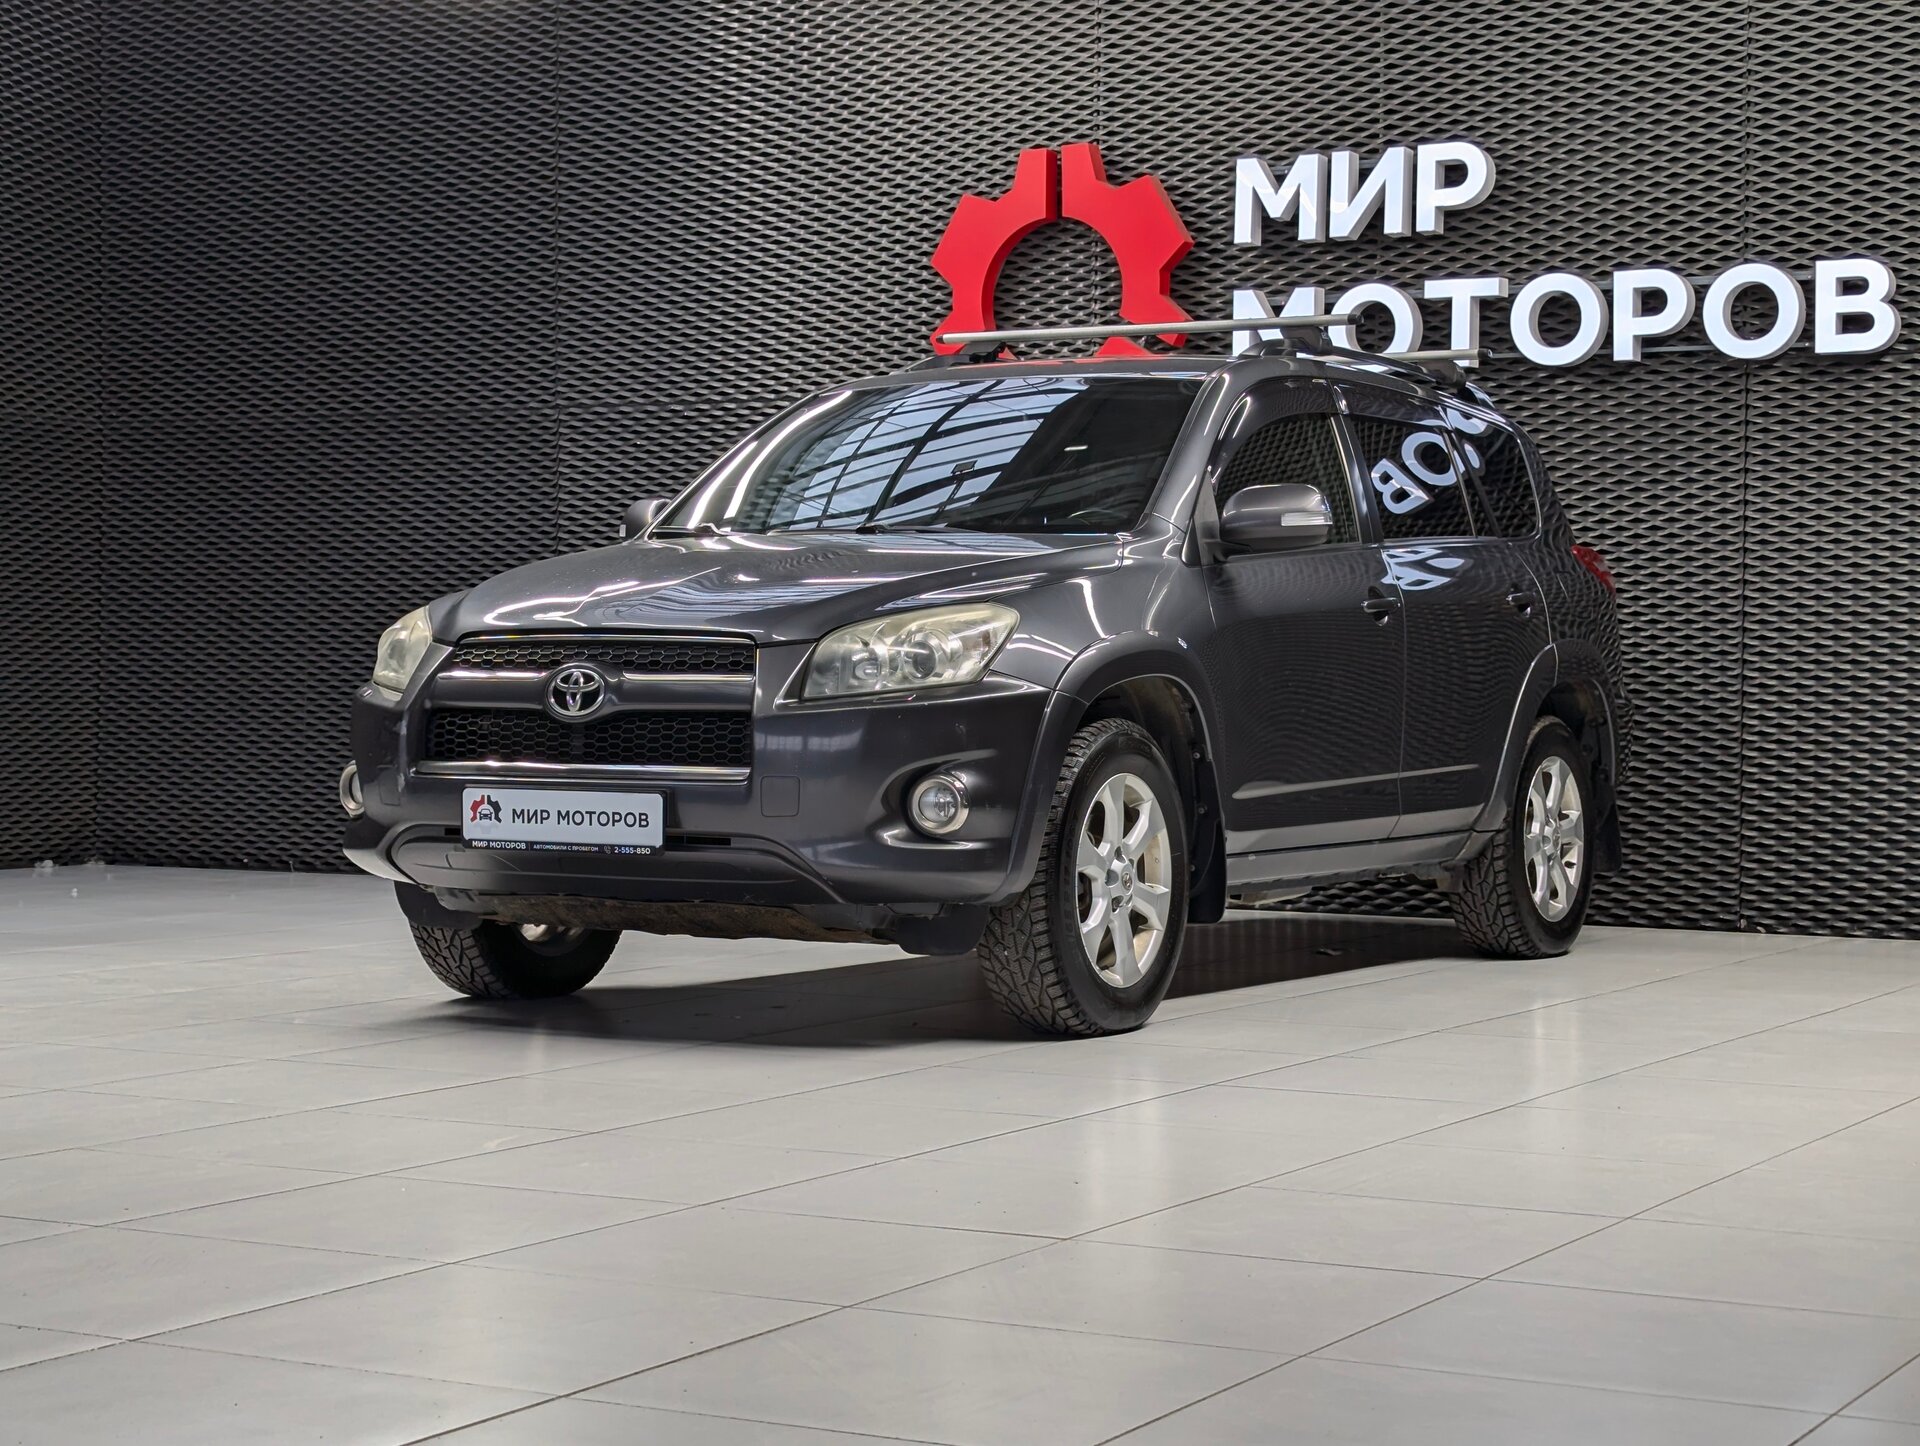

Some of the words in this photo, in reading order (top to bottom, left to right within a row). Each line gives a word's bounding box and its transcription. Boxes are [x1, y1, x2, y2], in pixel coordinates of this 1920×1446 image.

[1233, 141, 1497, 247] МИР
[1232, 258, 1900, 369] МОТОРОВ
[511, 808, 550, 825] МИР
[557, 810, 650, 828] МОТОРОВ
[472, 840, 488, 848] МИР
[490, 841, 526, 849] МОТОРОВ
[614, 846, 651, 855] 2-555-850
